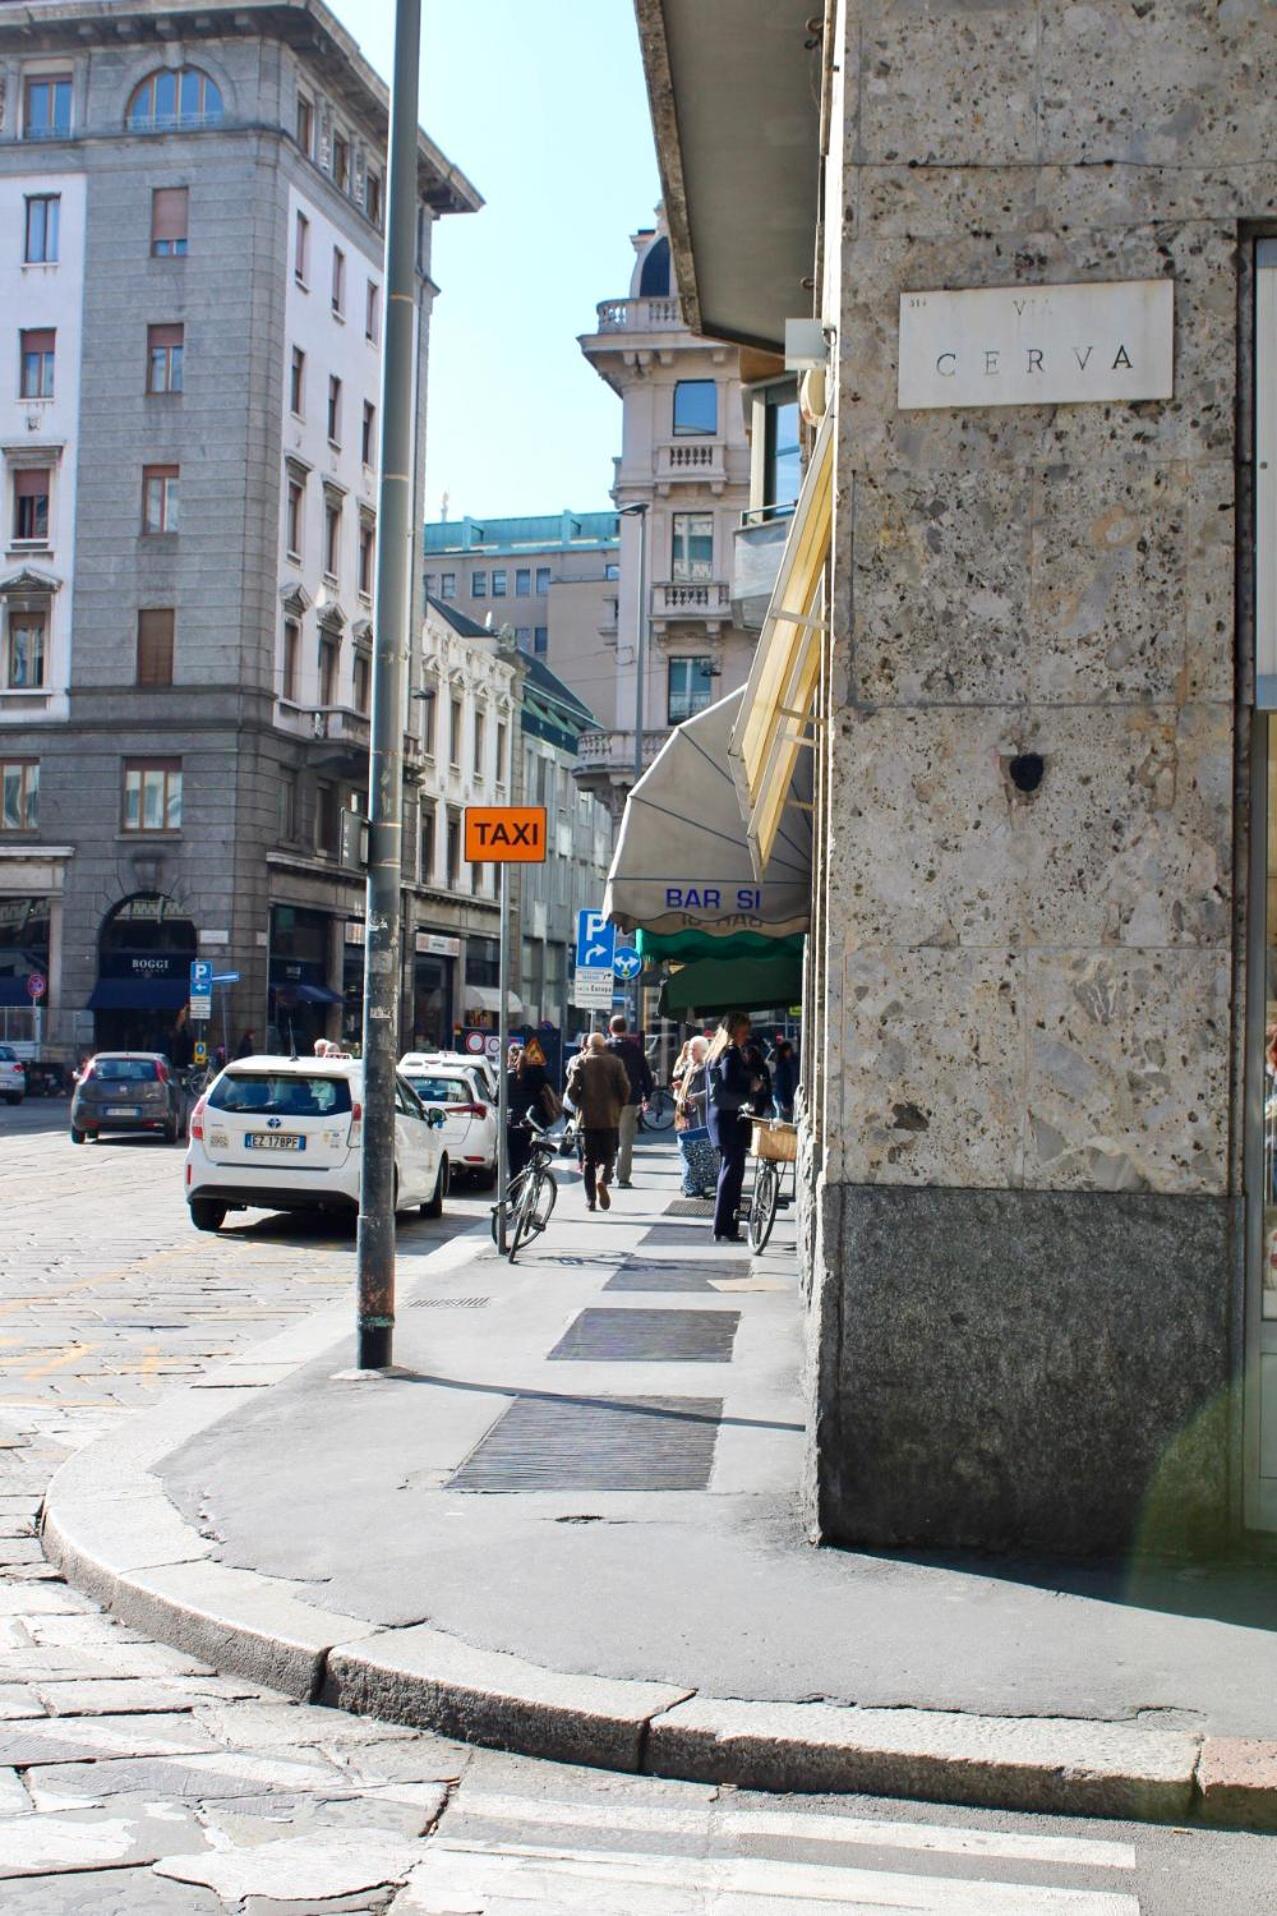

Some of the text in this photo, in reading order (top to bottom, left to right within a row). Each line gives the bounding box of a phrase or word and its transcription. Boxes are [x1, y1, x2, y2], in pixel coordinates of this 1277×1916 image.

[936, 345, 1133, 377] CERVA
[475, 823, 538, 845] TAXI
[666, 889, 760, 909] BAR SI
[586, 914, 606, 940] P
[132, 959, 169, 969] BOGGI
[195, 964, 206, 978] P
[252, 1135, 264, 1147] EZ
